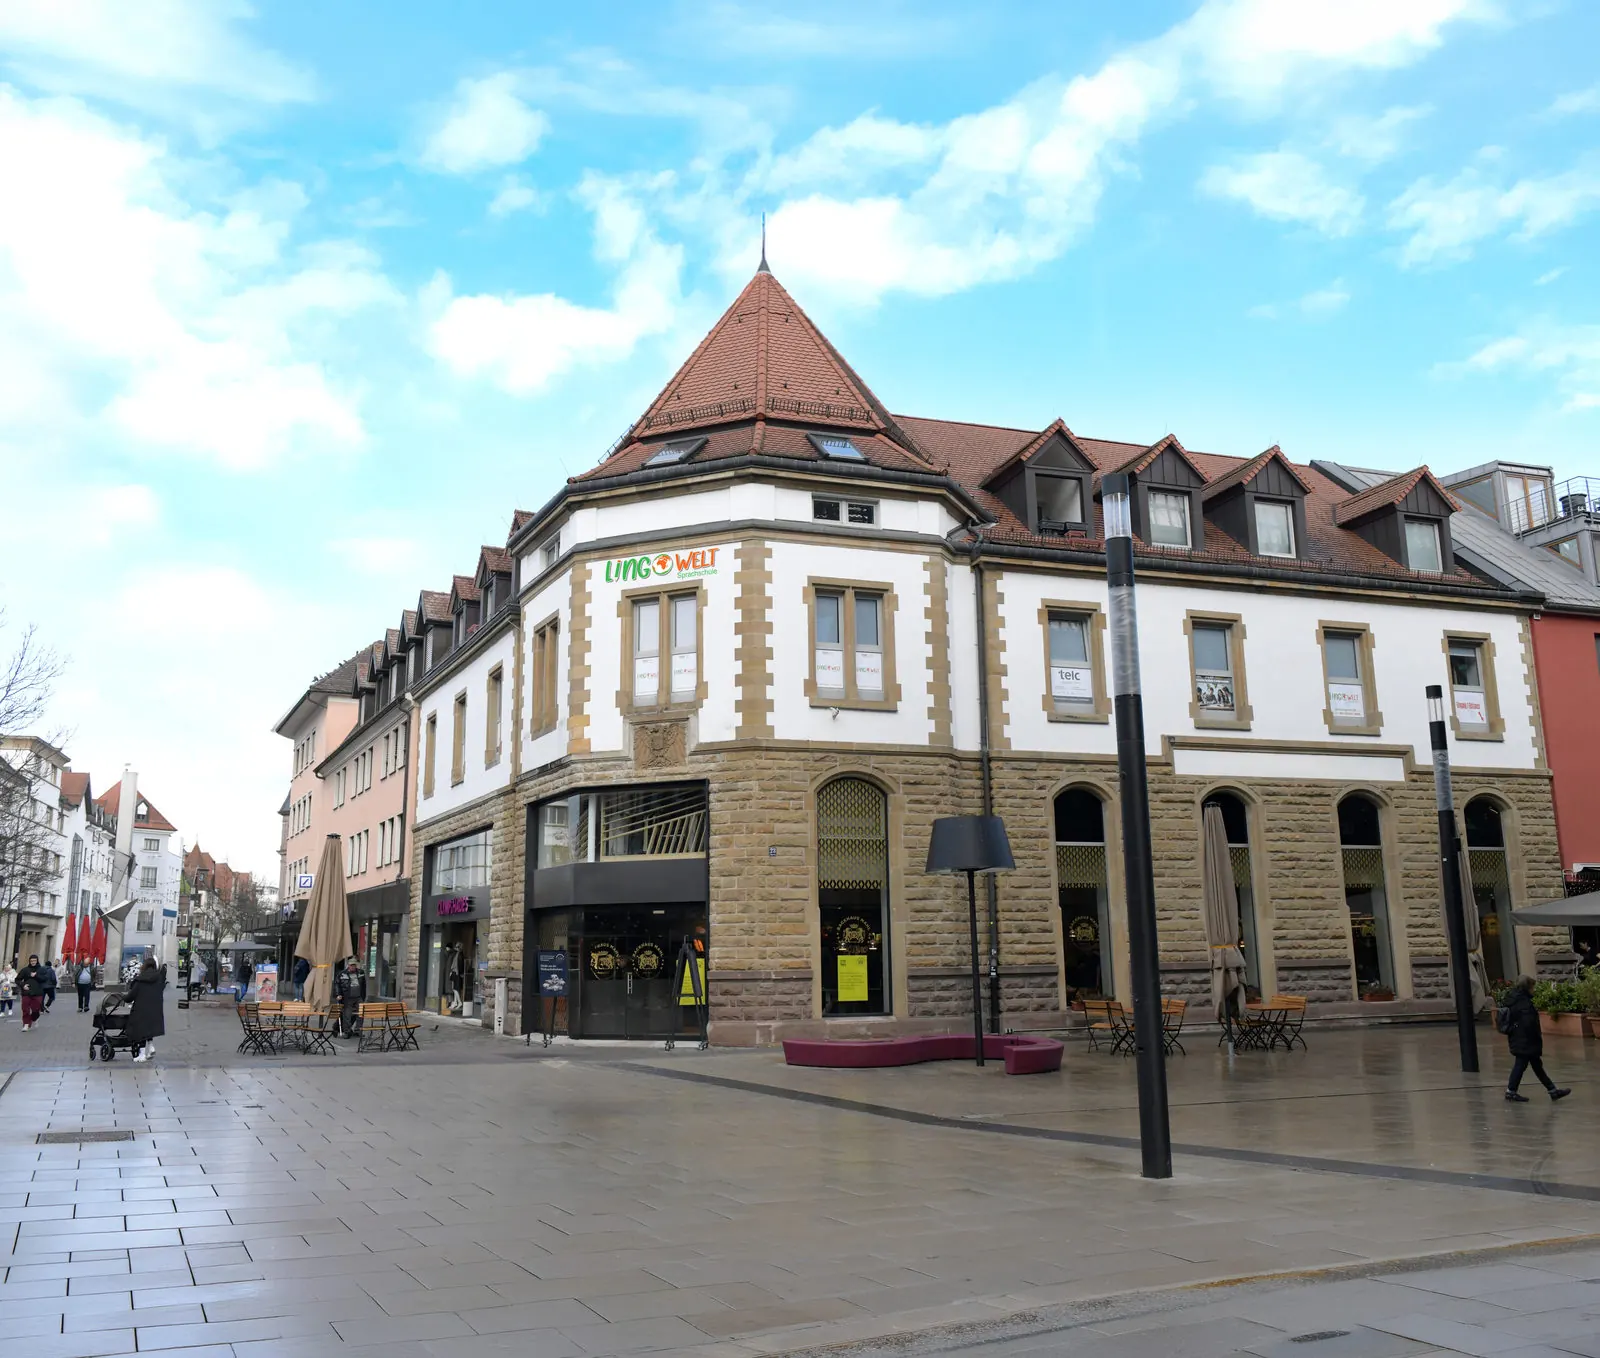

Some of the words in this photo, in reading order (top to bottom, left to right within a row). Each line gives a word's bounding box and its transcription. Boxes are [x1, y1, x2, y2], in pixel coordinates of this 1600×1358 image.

[675, 548, 720, 571] WELT
[677, 568, 718, 580] Sprachschule
[1058, 669, 1080, 680] telc
